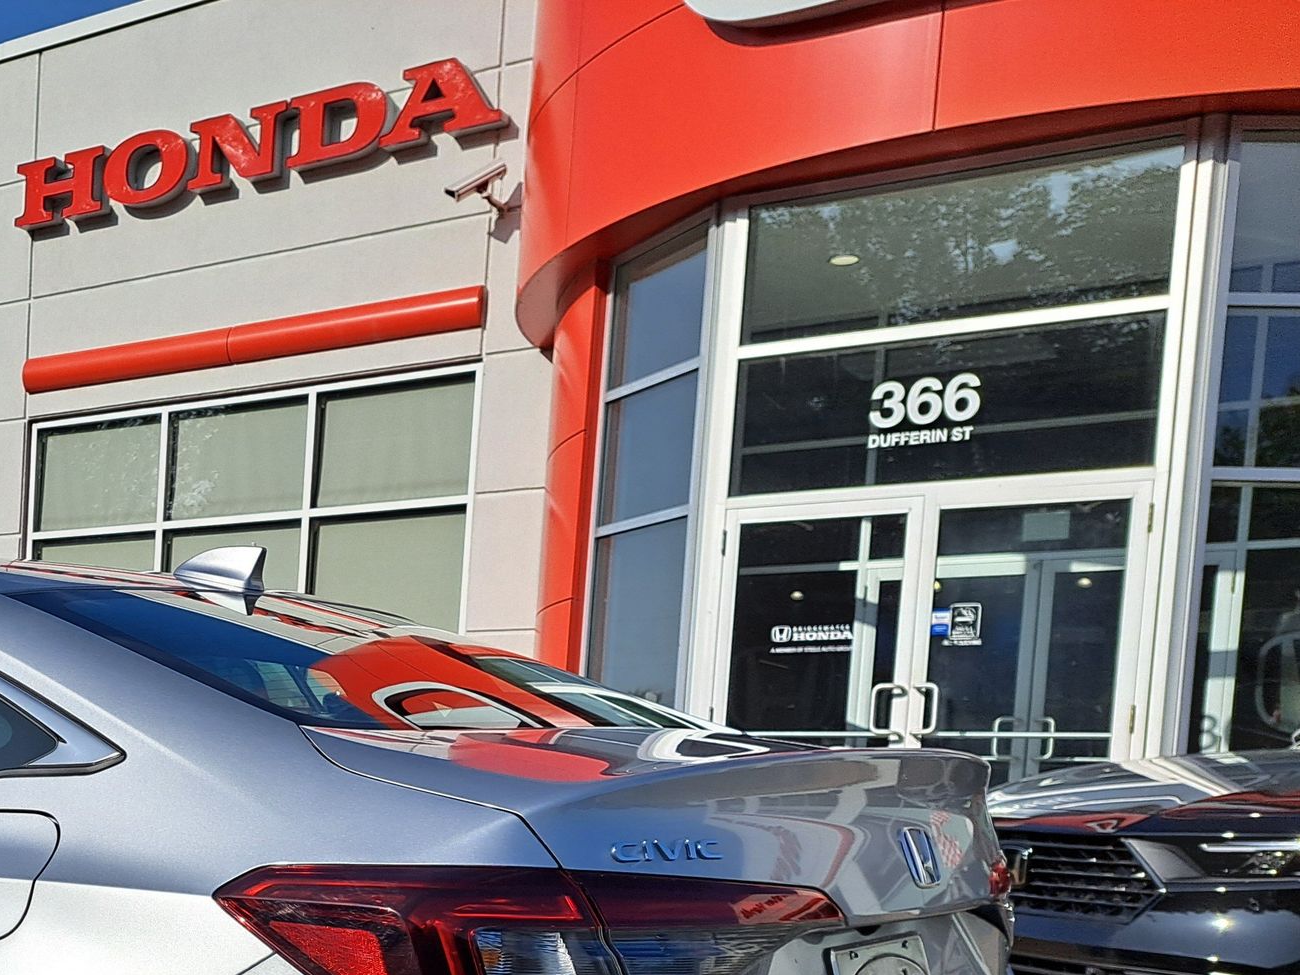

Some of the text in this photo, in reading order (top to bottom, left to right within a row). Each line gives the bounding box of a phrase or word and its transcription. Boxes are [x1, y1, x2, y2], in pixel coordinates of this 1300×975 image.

[14, 57, 504, 230] HONDA
[868, 372, 981, 429] 366
[867, 425, 975, 449] DUFFERIN ST
[791, 632, 855, 642] HONDA
[610, 839, 723, 863] CIVIC
